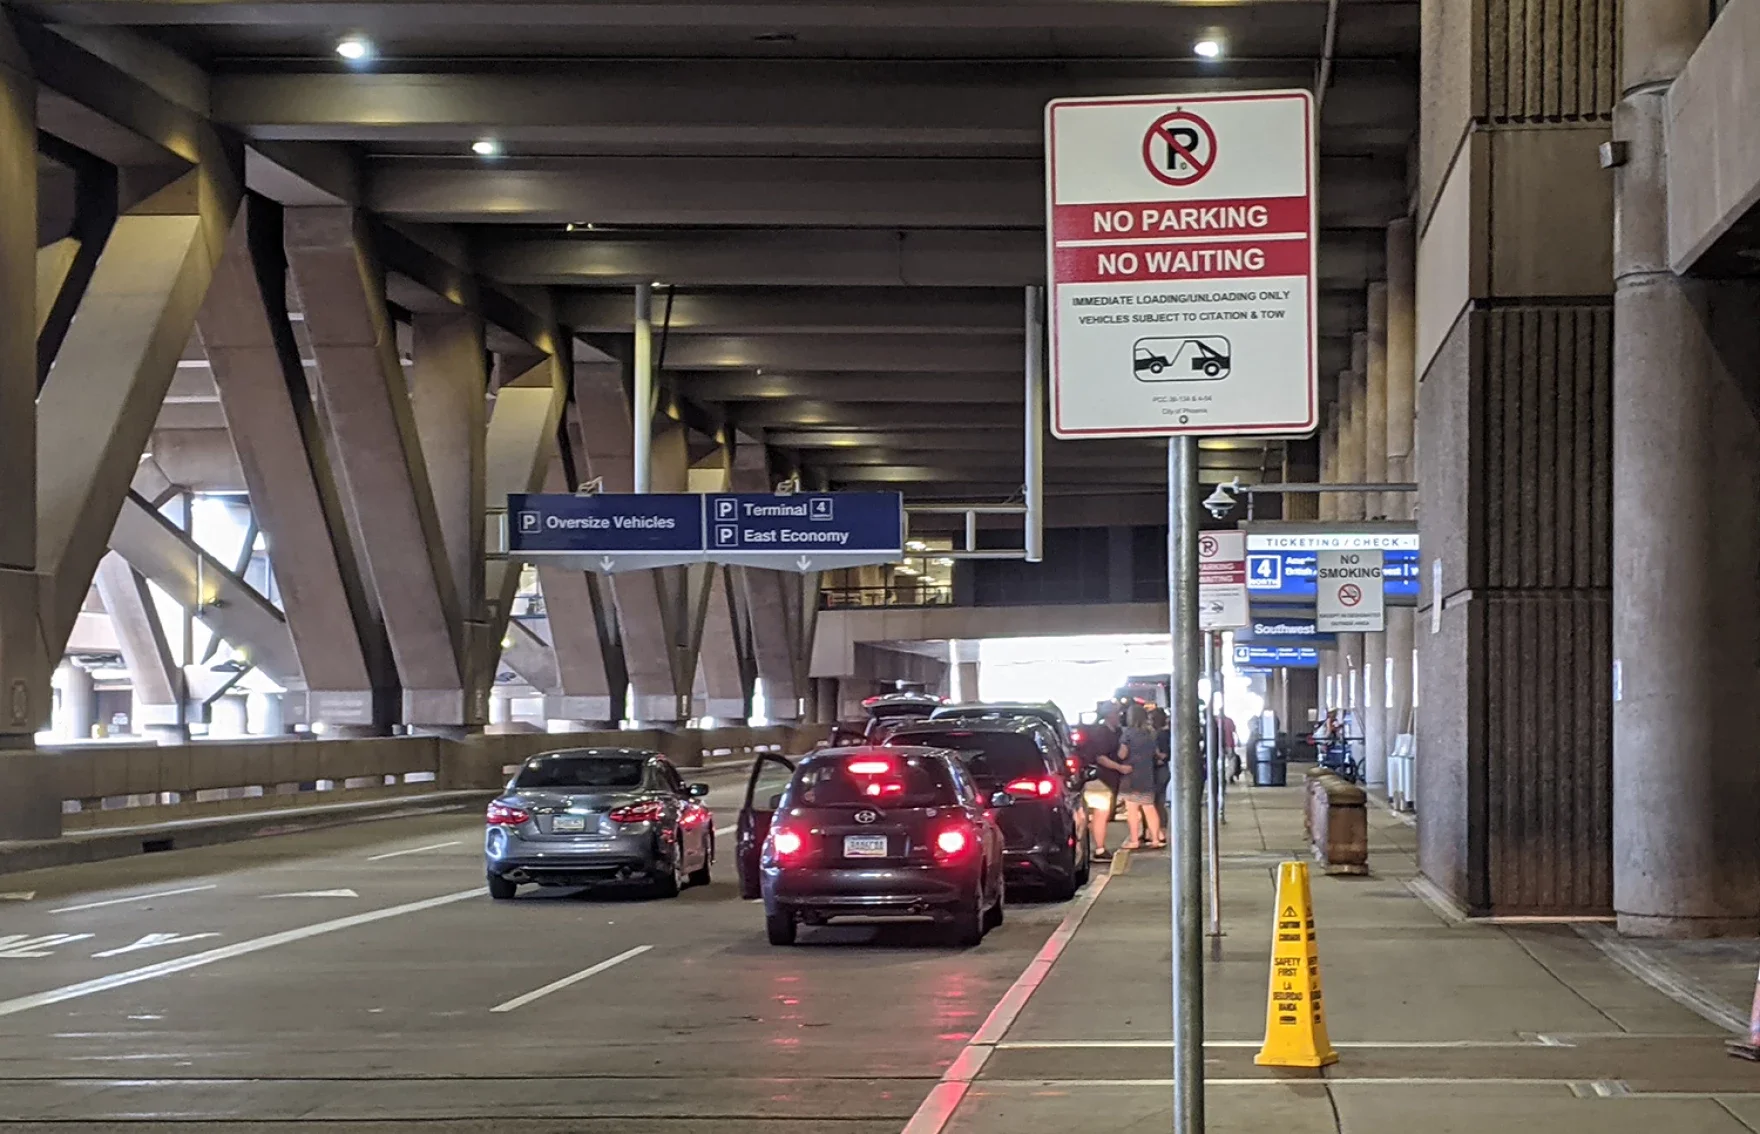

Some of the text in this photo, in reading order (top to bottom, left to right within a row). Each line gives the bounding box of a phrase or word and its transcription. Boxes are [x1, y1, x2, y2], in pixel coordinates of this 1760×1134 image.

[1093, 206, 1268, 232] NO PARKING
[1098, 248, 1265, 275] NO WAITING
[1072, 290, 1290, 306] IMMEDIATE LOADING/UNLOADING ONLY
[1079, 310, 1286, 324] VEHICLES SUBJECT TO CITATION & TOW
[720, 501, 826, 517] P Terminal 4
[524, 515, 675, 529] P Oversize Vehicles
[720, 529, 849, 545] P East Economy
[1266, 538, 1340, 547] TICKETING
[1340, 554, 1360, 564] NO
[1200, 562, 1235, 571] ARKING
[1257, 559, 1271, 578] 4
[1319, 567, 1381, 579] SMOKING
[1254, 624, 1316, 635] Southwest
[1275, 958, 1300, 966] SAFETY
[1278, 968, 1297, 976] FIRST
